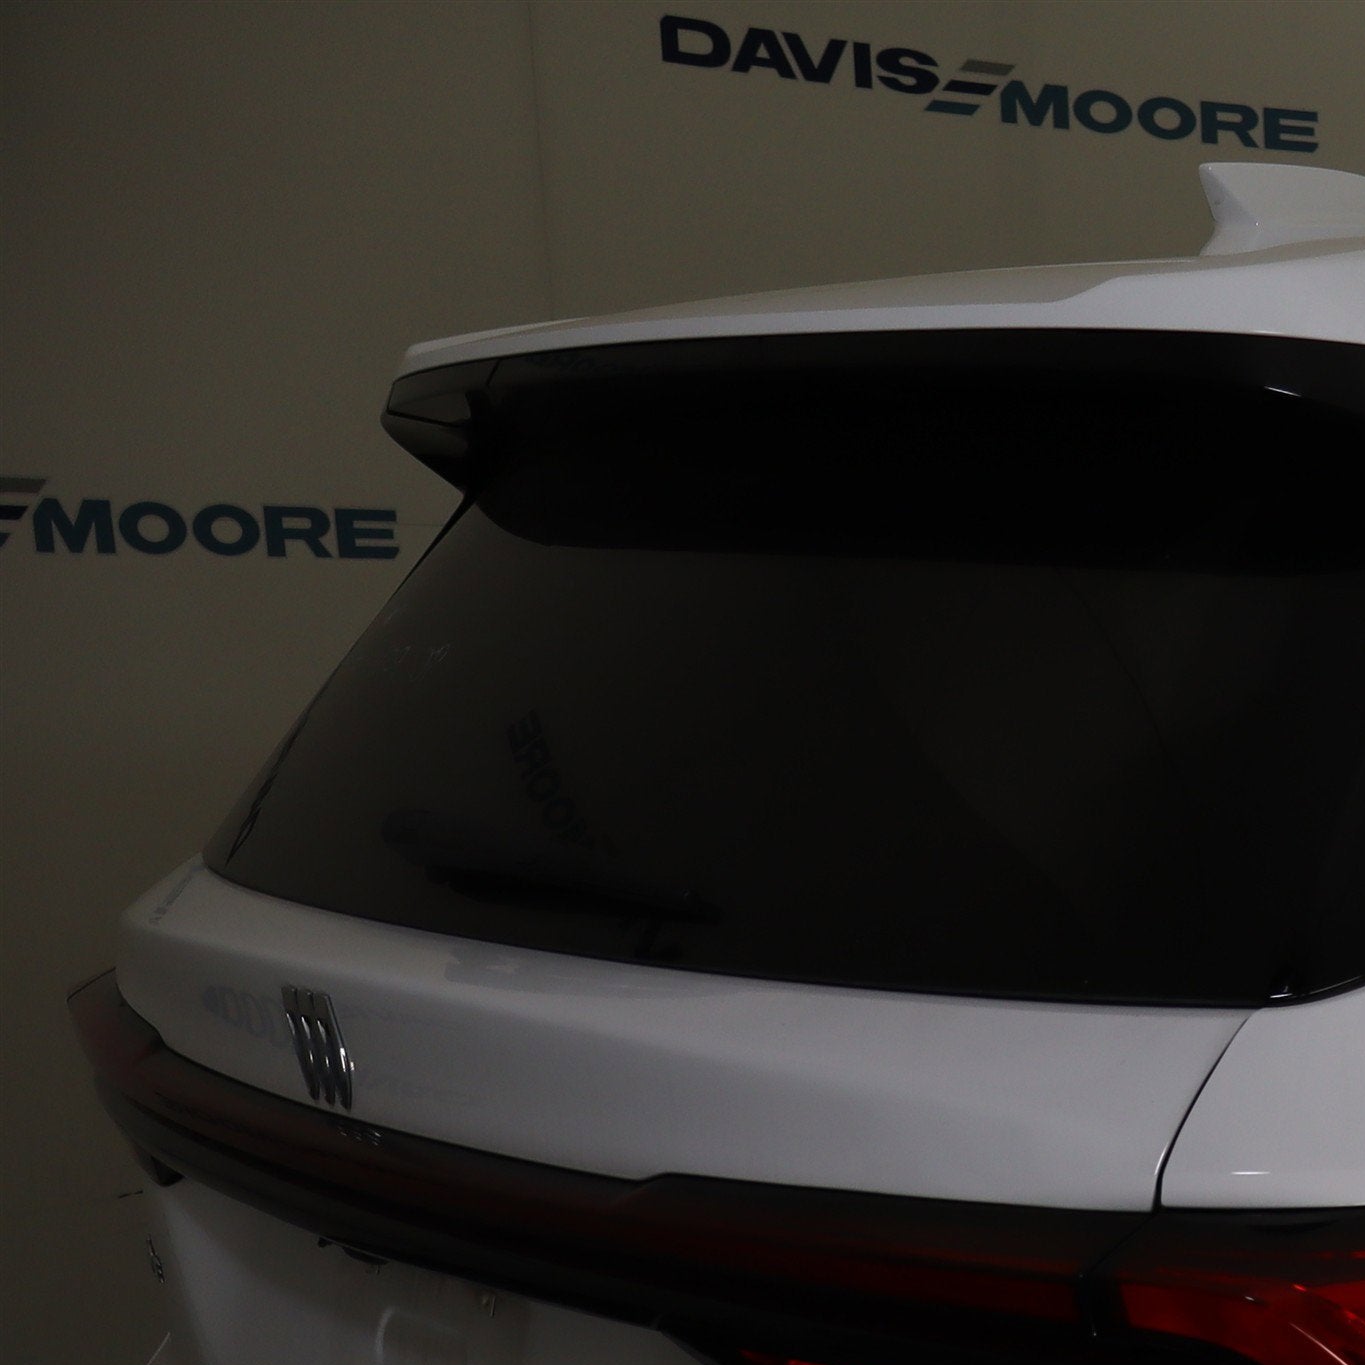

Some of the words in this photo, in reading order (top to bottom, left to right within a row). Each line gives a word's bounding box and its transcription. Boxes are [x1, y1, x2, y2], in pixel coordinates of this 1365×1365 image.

[660, 15, 940, 95] DAVIS
[1000, 79, 1319, 153] MOORE
[33, 498, 400, 560] MOORE
